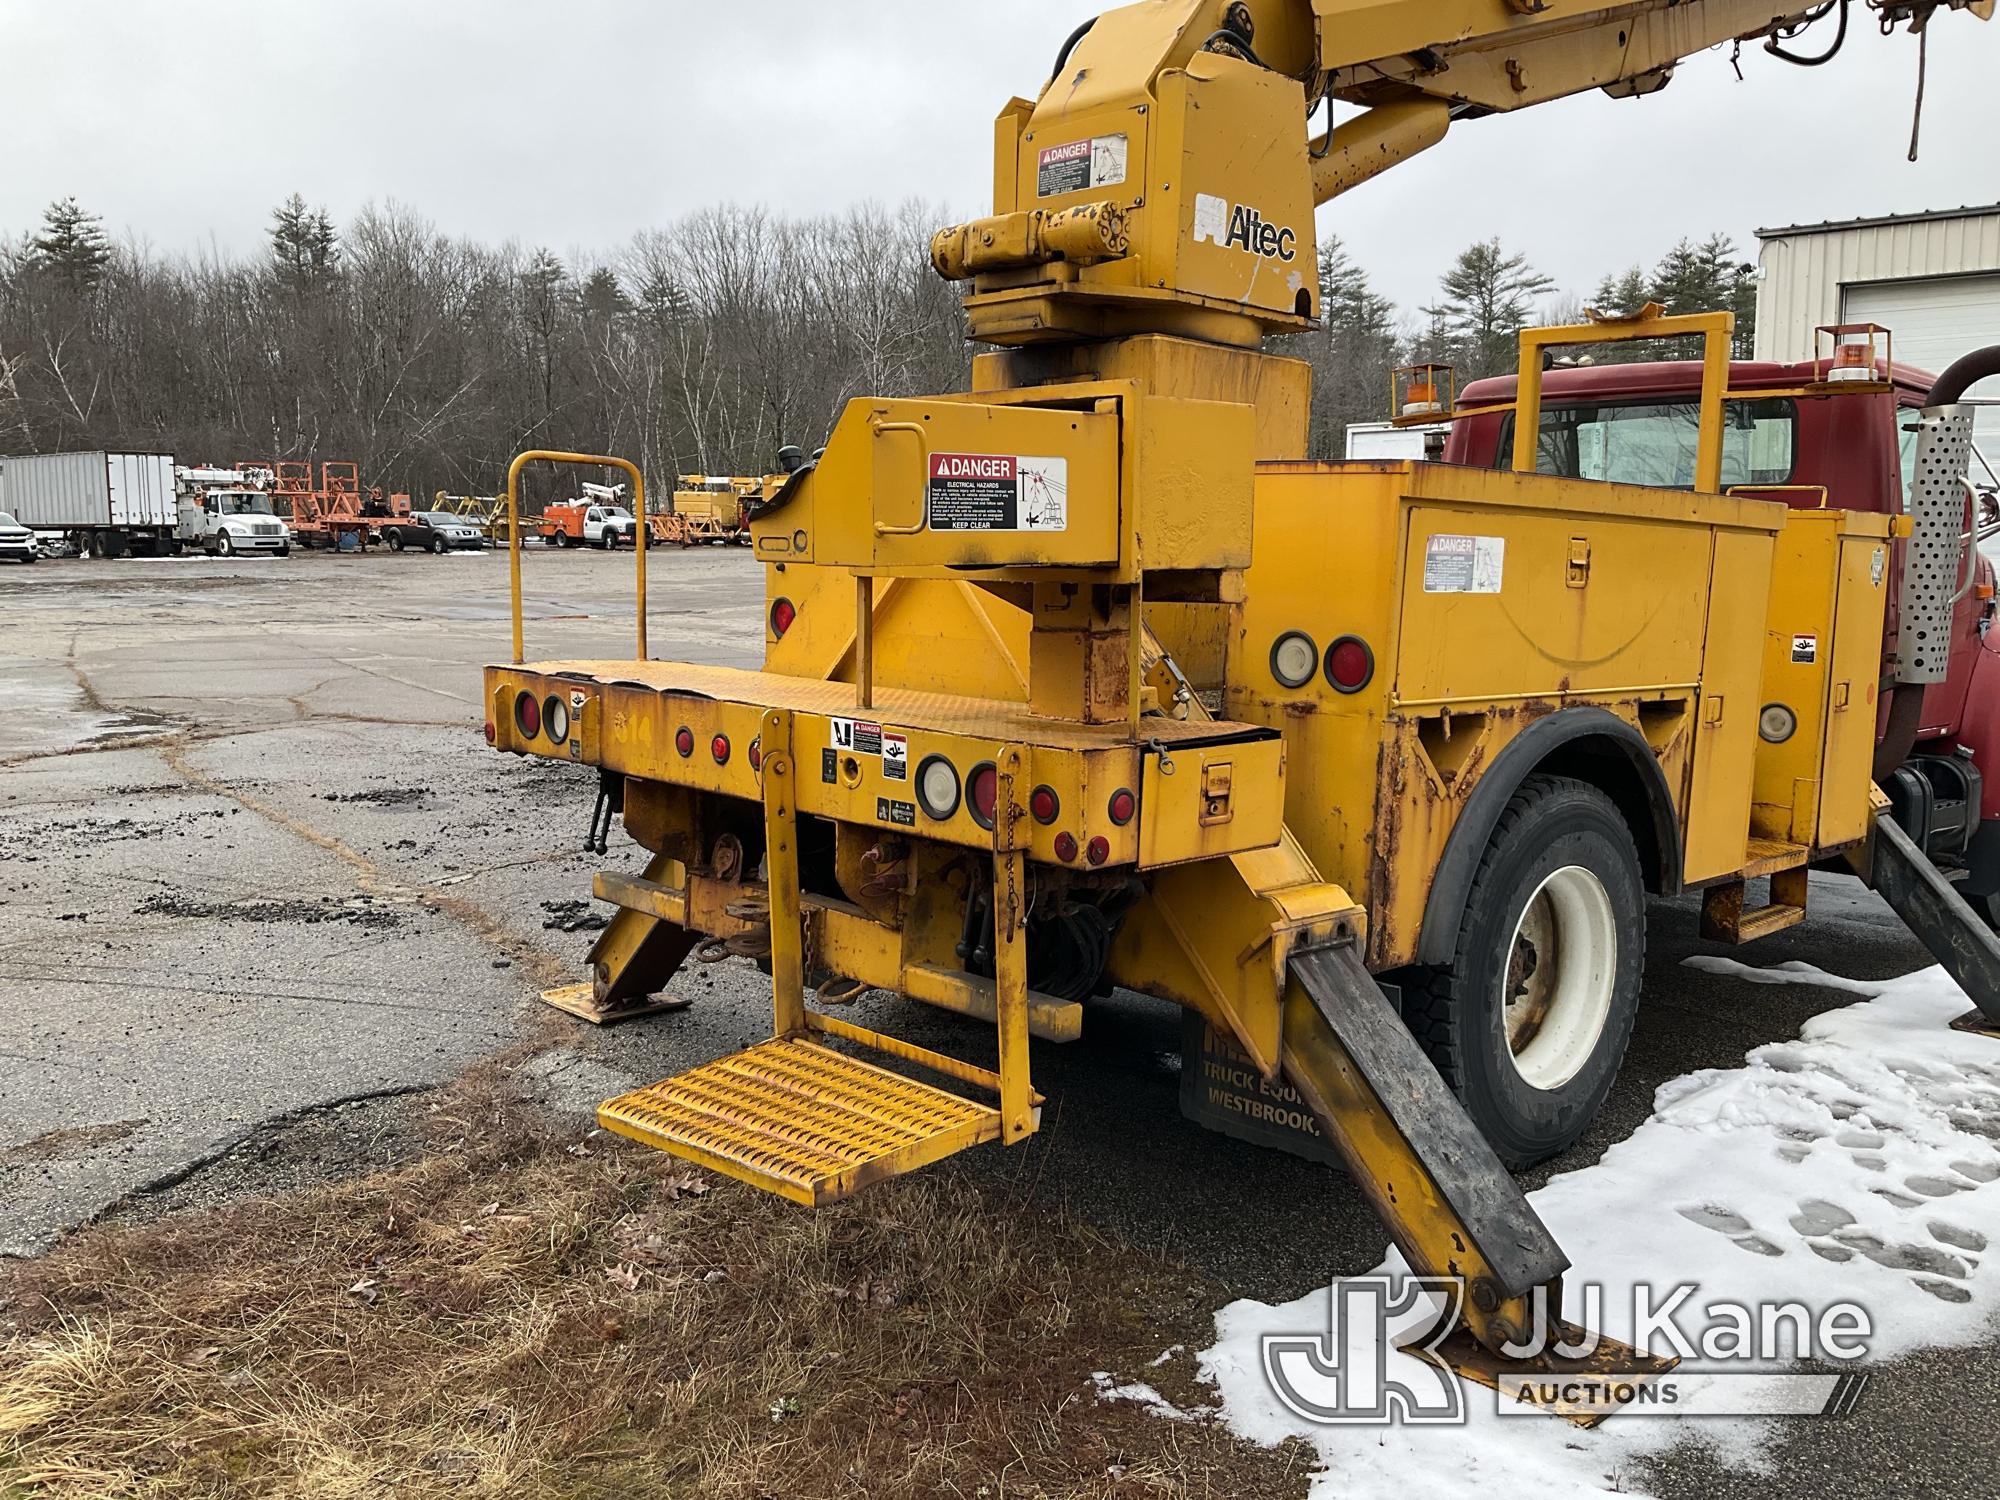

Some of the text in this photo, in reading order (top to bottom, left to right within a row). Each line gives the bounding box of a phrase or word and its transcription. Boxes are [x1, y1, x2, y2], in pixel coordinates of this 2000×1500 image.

[1051, 143, 1088, 161] DANGER
[1224, 204, 1296, 262] Altec
[951, 458, 1010, 477] DANGER
[970, 521, 990, 529] CLEAR
[1439, 538, 1473, 552] DANGER
[1203, 1061, 1254, 1090] TRUCK
